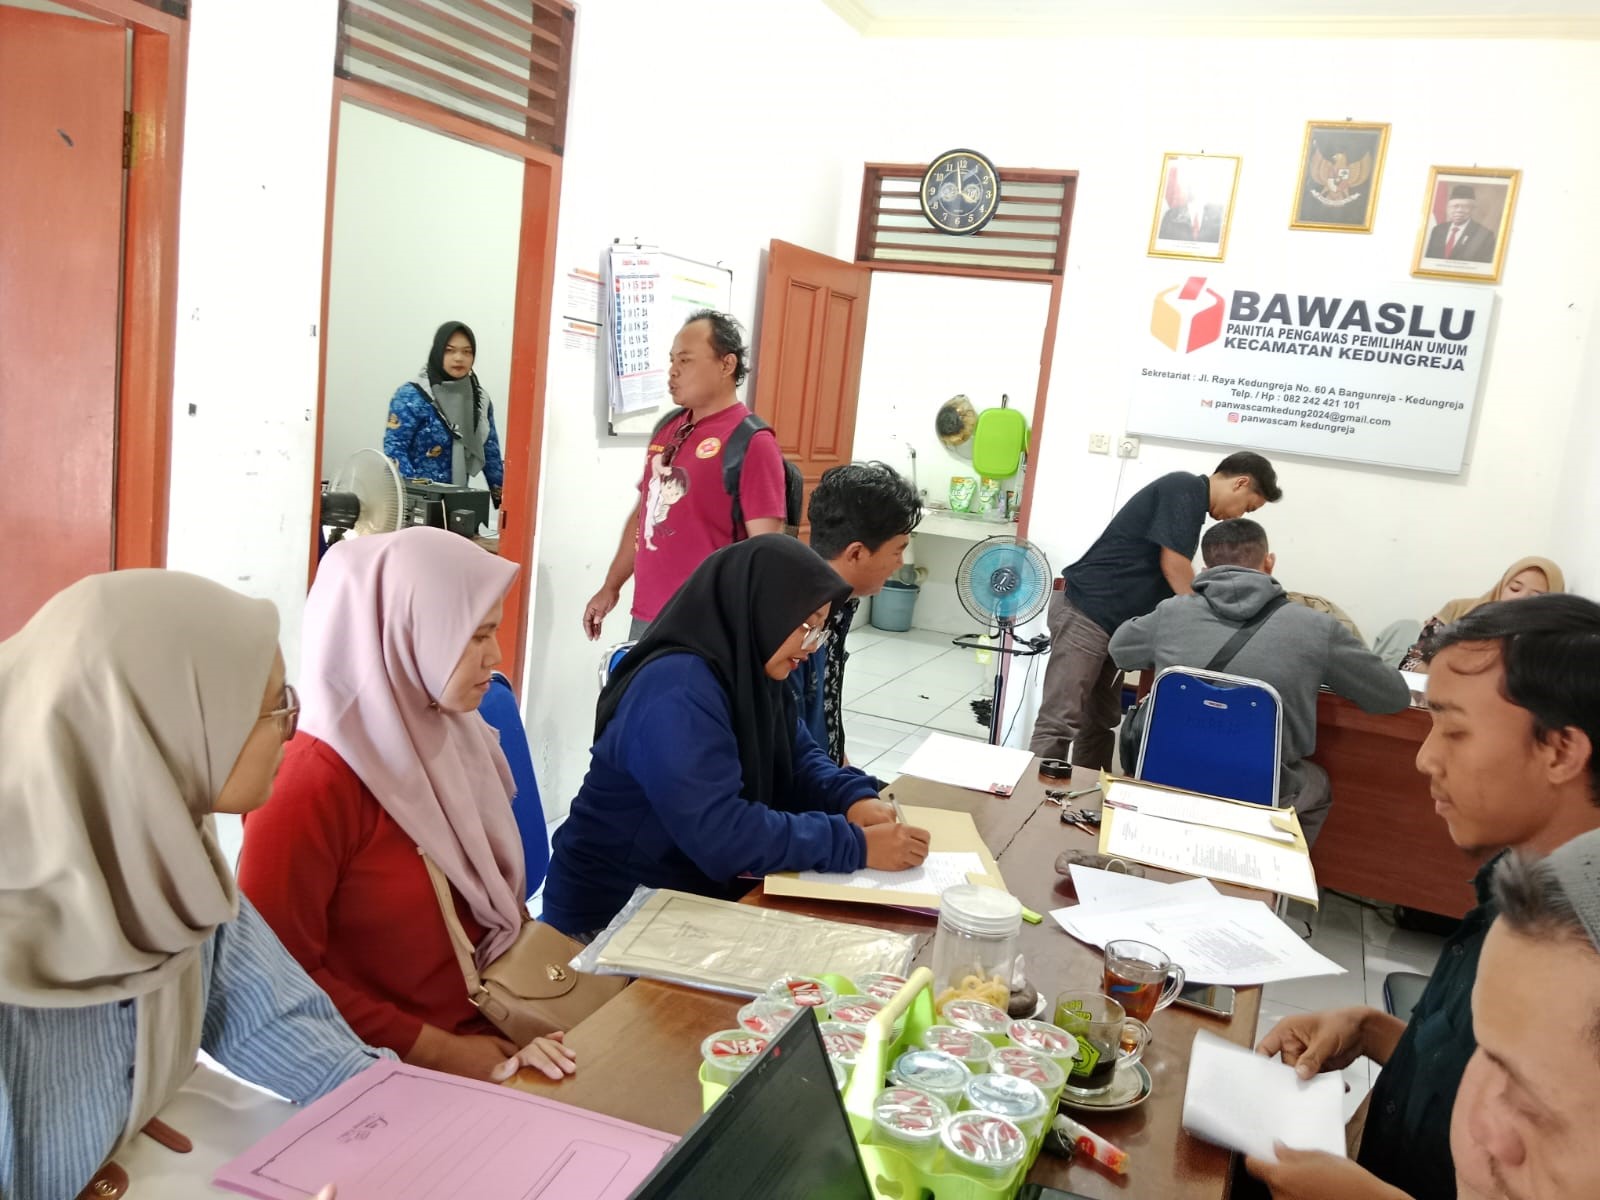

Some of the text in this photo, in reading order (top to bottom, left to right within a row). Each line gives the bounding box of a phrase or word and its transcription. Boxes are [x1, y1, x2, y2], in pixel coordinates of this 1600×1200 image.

[1229, 289, 1476, 341] BAWASLU
[1224, 336, 1465, 371] KECAMATAN KEDUNGREJA
[1226, 323, 1468, 357] PANITIA PENGAWAS PEMILIHAN UMUM
[1141, 368, 1191, 381] Sekretariat
[1211, 375, 1235, 386] Raya
[1238, 377, 1293, 391] Kedungreja
[1295, 383, 1312, 393] No.
[1314, 385, 1326, 395] 60
[1328, 387, 1336, 396] A
[1338, 388, 1396, 403] Bangunreja
[1405, 395, 1464, 410] Kedungreja
[1231, 388, 1253, 399] Telp.
[1261, 392, 1275, 402] Hp
[1283, 393, 1301, 404] 082
[1303, 396, 1320, 406] 242
[1322, 398, 1340, 408] 421
[1344, 400, 1360, 410] 101
[1215, 400, 1392, 427] panwascamkedung2024@gmail.com
[1241, 413, 1355, 434] panwascam kedungreja
[713, 1038, 764, 1056] Vit
